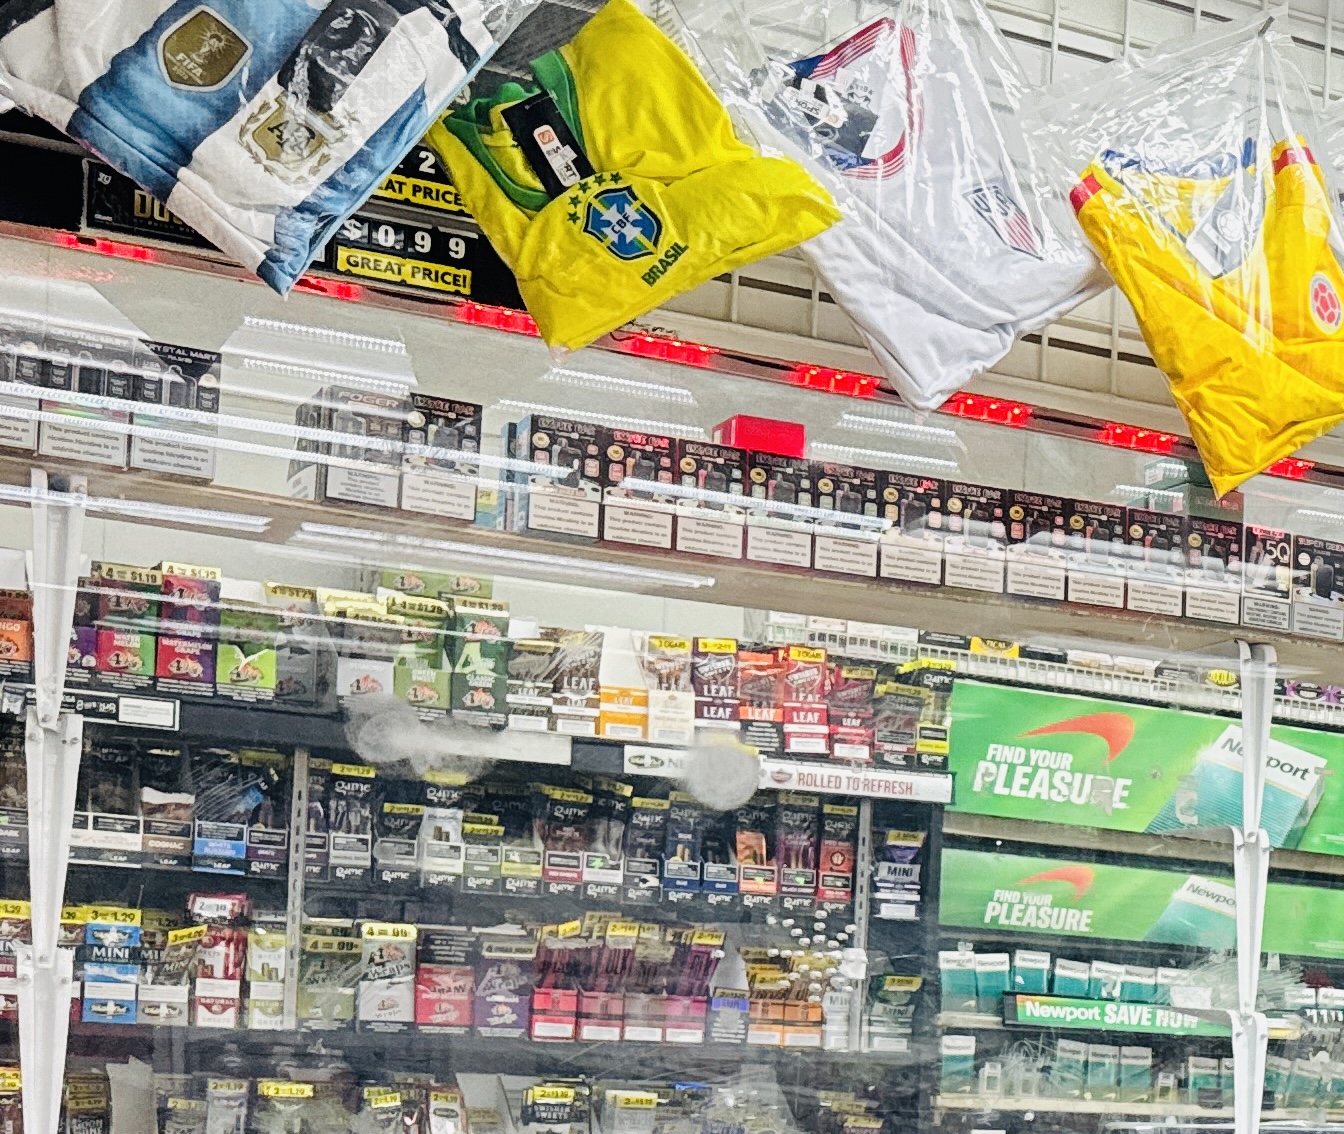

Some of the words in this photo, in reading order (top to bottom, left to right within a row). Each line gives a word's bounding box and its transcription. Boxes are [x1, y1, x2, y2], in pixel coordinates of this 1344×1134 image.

[346, 255, 402, 276] GREAT
[408, 266, 468, 288] PRICE!
[641, 241, 689, 287] BRASIL
[987, 744, 1025, 764] FIND
[1029, 748, 1073, 770] YOUR
[798, 772, 842, 790] ROLLED
[863, 778, 913, 796] REFRESH
[994, 889, 1019, 903] FIND
[1023, 892, 1053, 905] YOUR
[1025, 1002, 1101, 1022] Newport
[1104, 1005, 1151, 1025] SAVE
